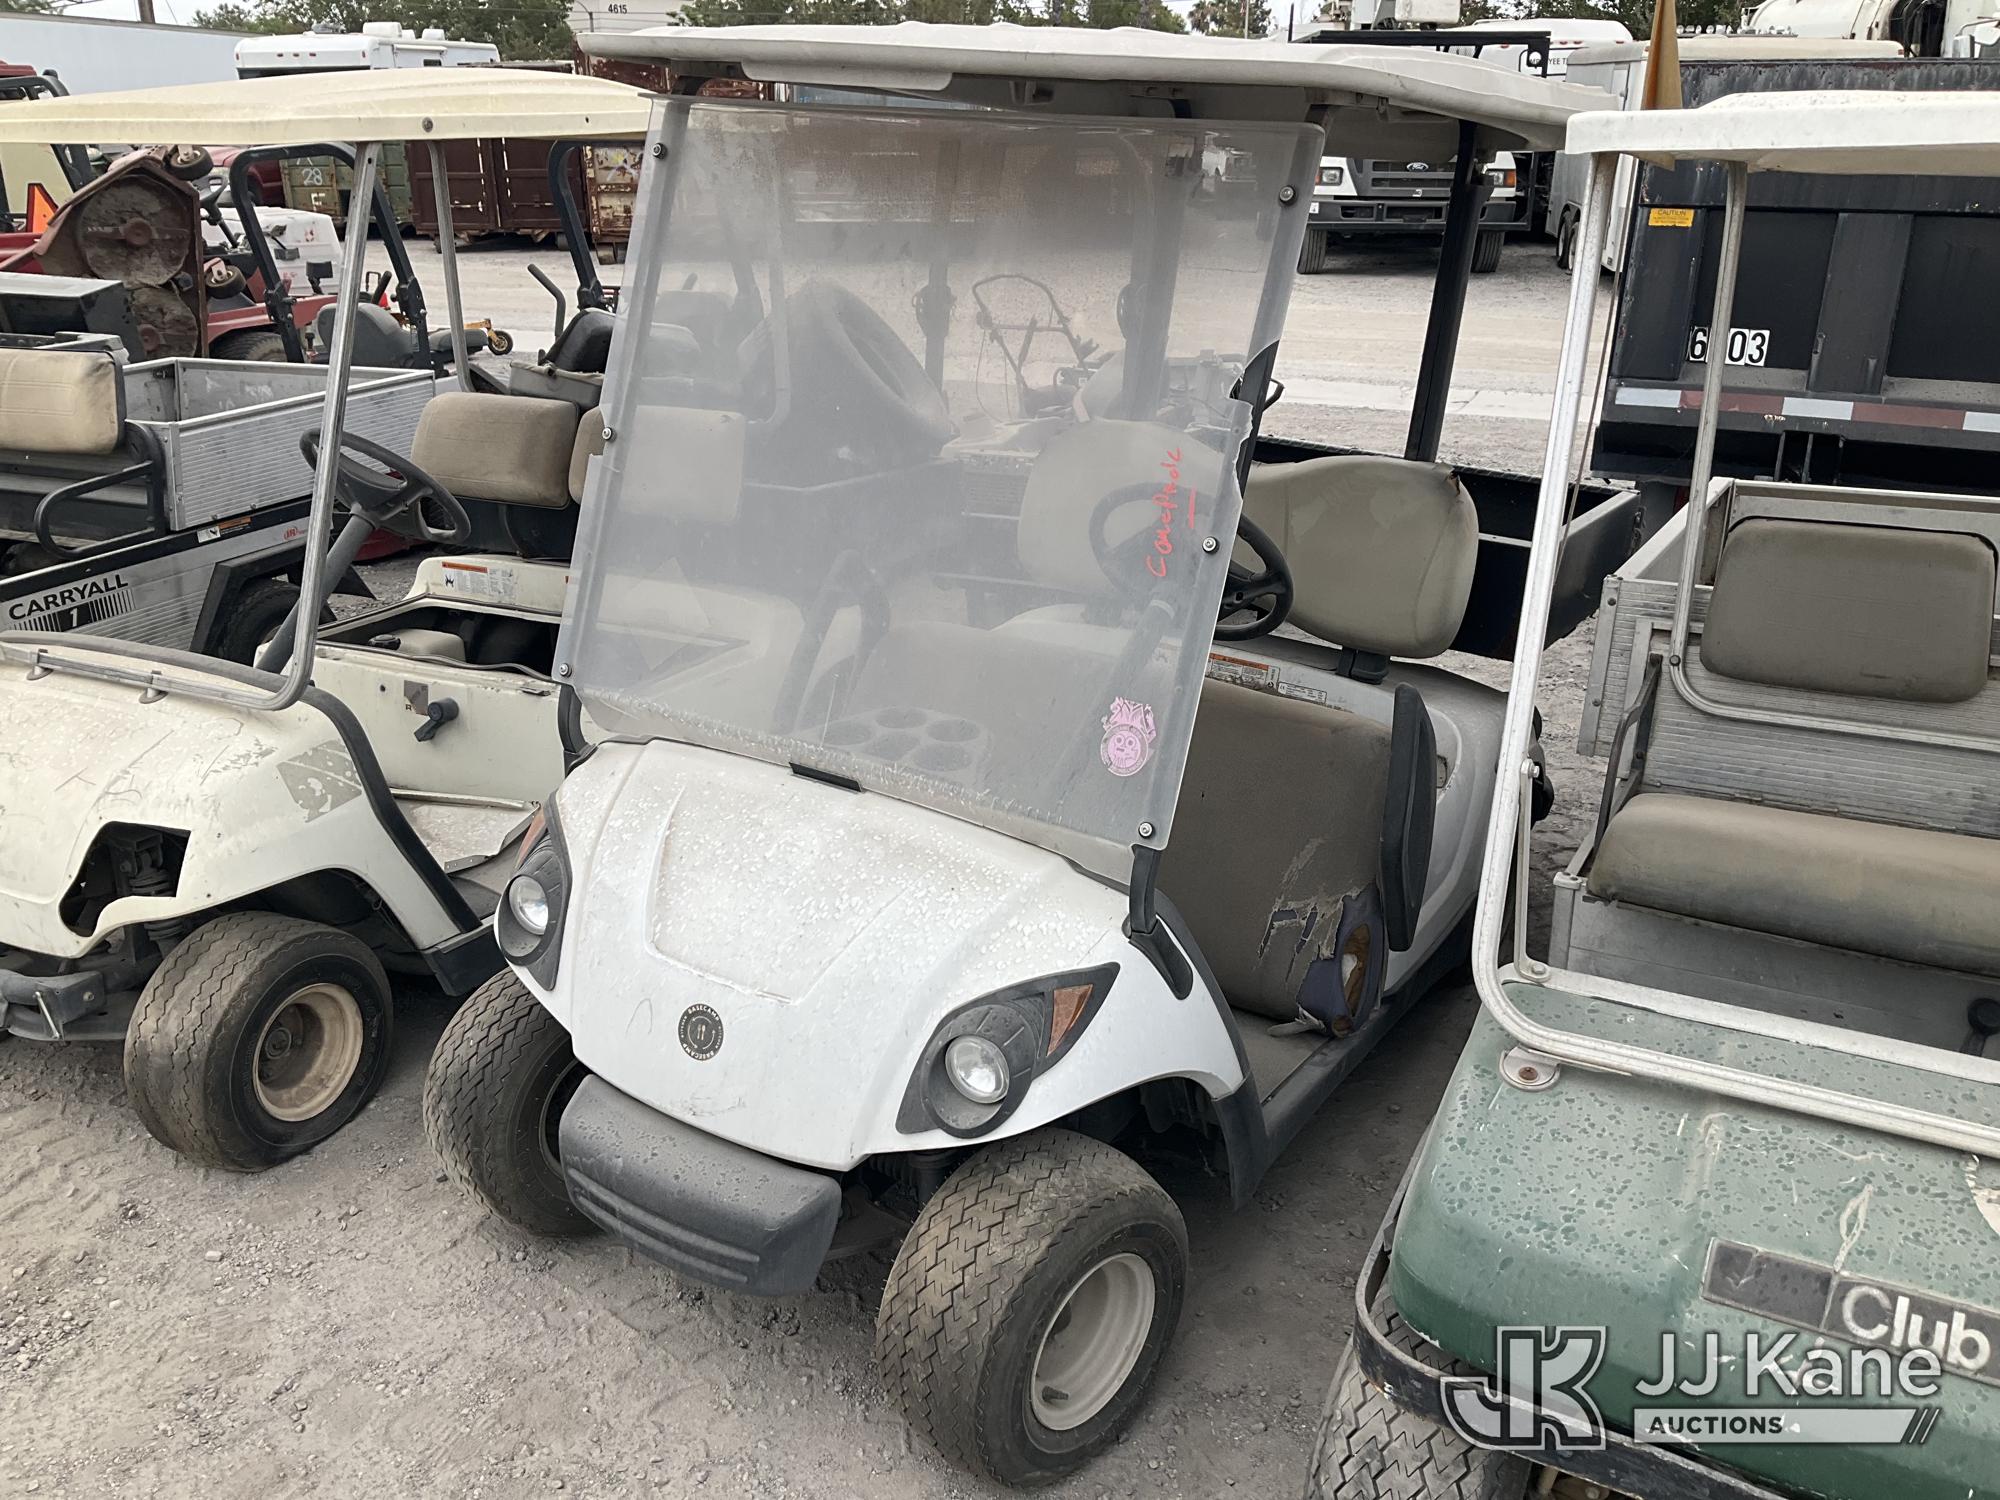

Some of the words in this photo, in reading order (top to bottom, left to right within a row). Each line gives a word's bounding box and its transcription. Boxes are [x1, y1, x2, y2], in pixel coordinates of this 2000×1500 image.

[608, 3, 628, 14] 4615
[302, 168, 323, 186] 28
[1690, 327, 1766, 364] 603
[8, 574, 129, 620] CARRYALL
[69, 607, 78, 628] 1
[1842, 1285, 1991, 1370] Club
